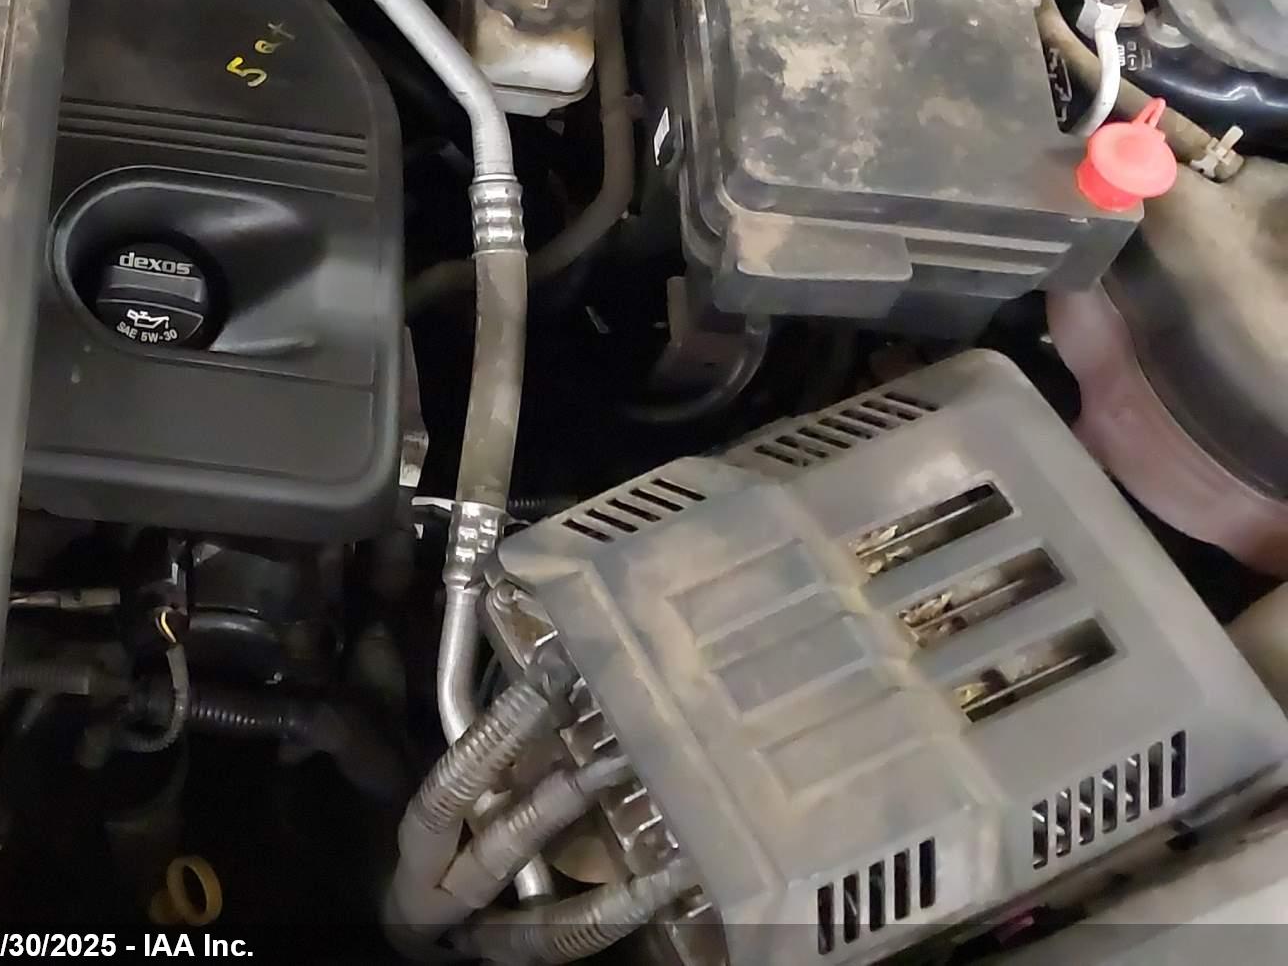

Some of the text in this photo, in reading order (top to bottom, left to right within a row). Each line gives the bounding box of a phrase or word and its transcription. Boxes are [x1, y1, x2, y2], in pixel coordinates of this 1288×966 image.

[226, 56, 268, 87] 5
[119, 252, 194, 275] dexos
[116, 321, 178, 343] SAE 5W-30
